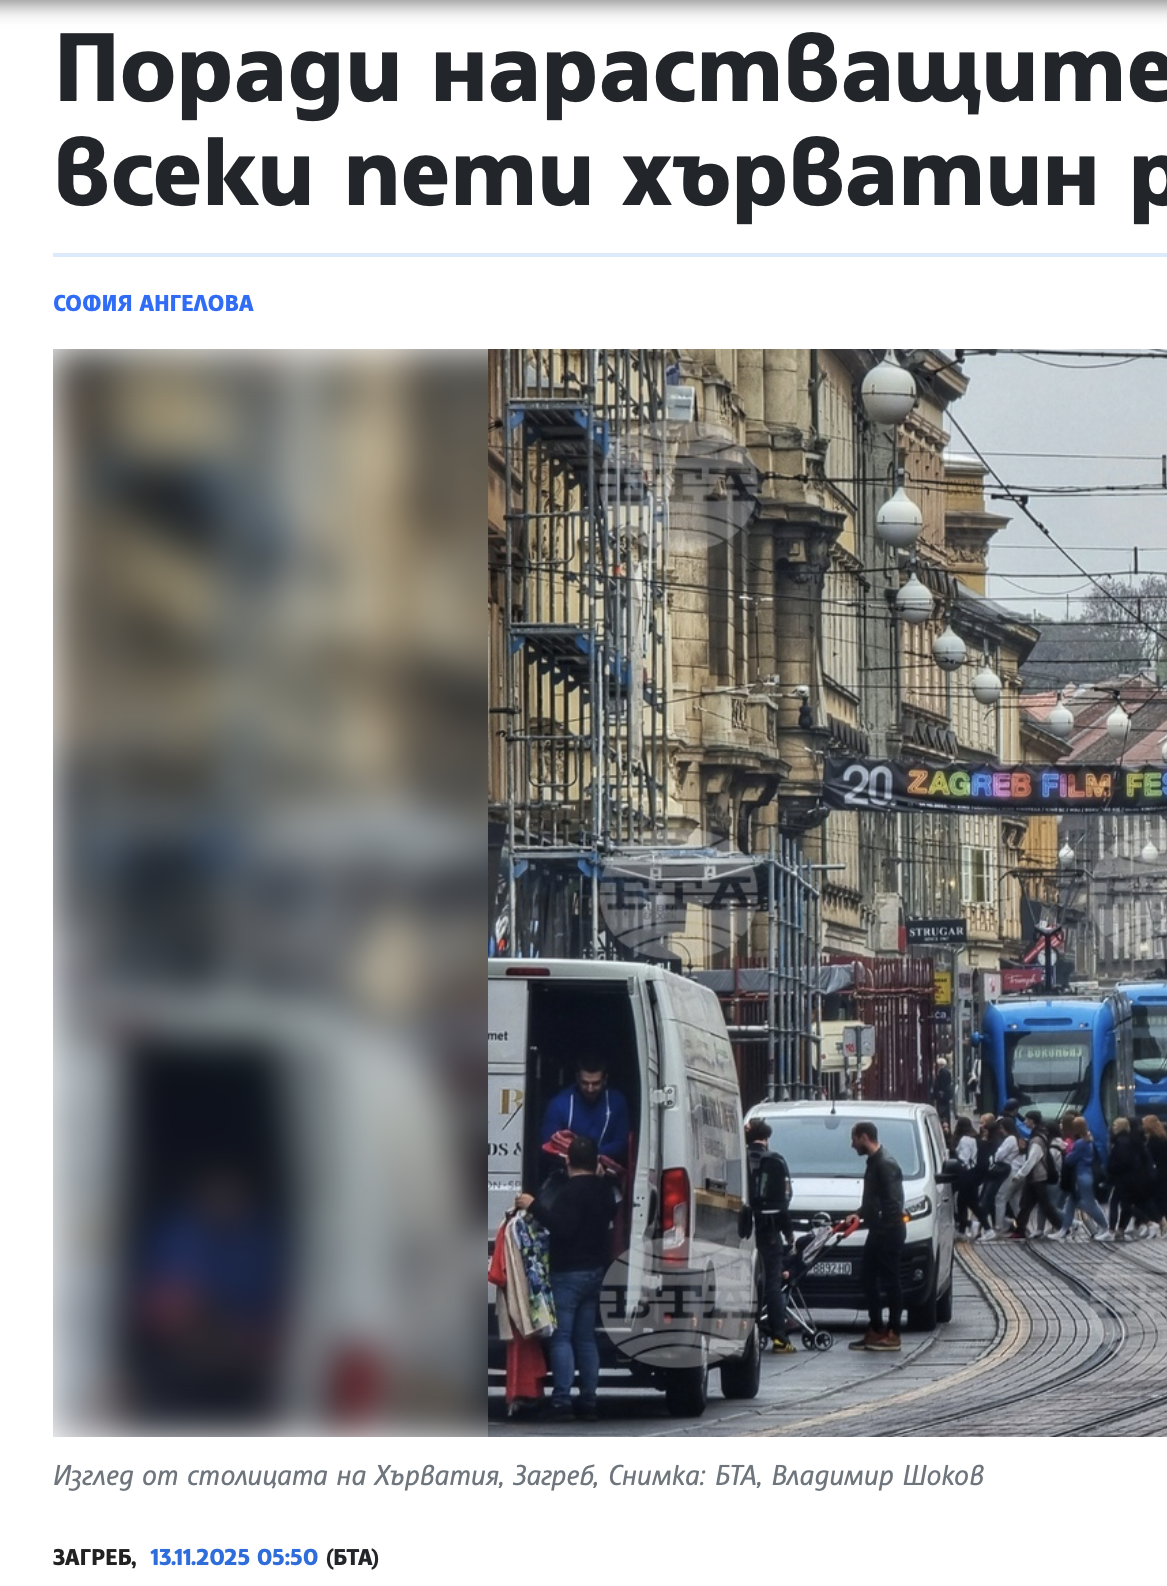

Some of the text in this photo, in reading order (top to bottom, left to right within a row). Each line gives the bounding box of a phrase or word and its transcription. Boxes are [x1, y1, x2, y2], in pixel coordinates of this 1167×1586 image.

[907, 768, 1032, 798] ZAGREB
[1041, 772, 1112, 798] FILM
[909, 926, 964, 937] STRUGAR
